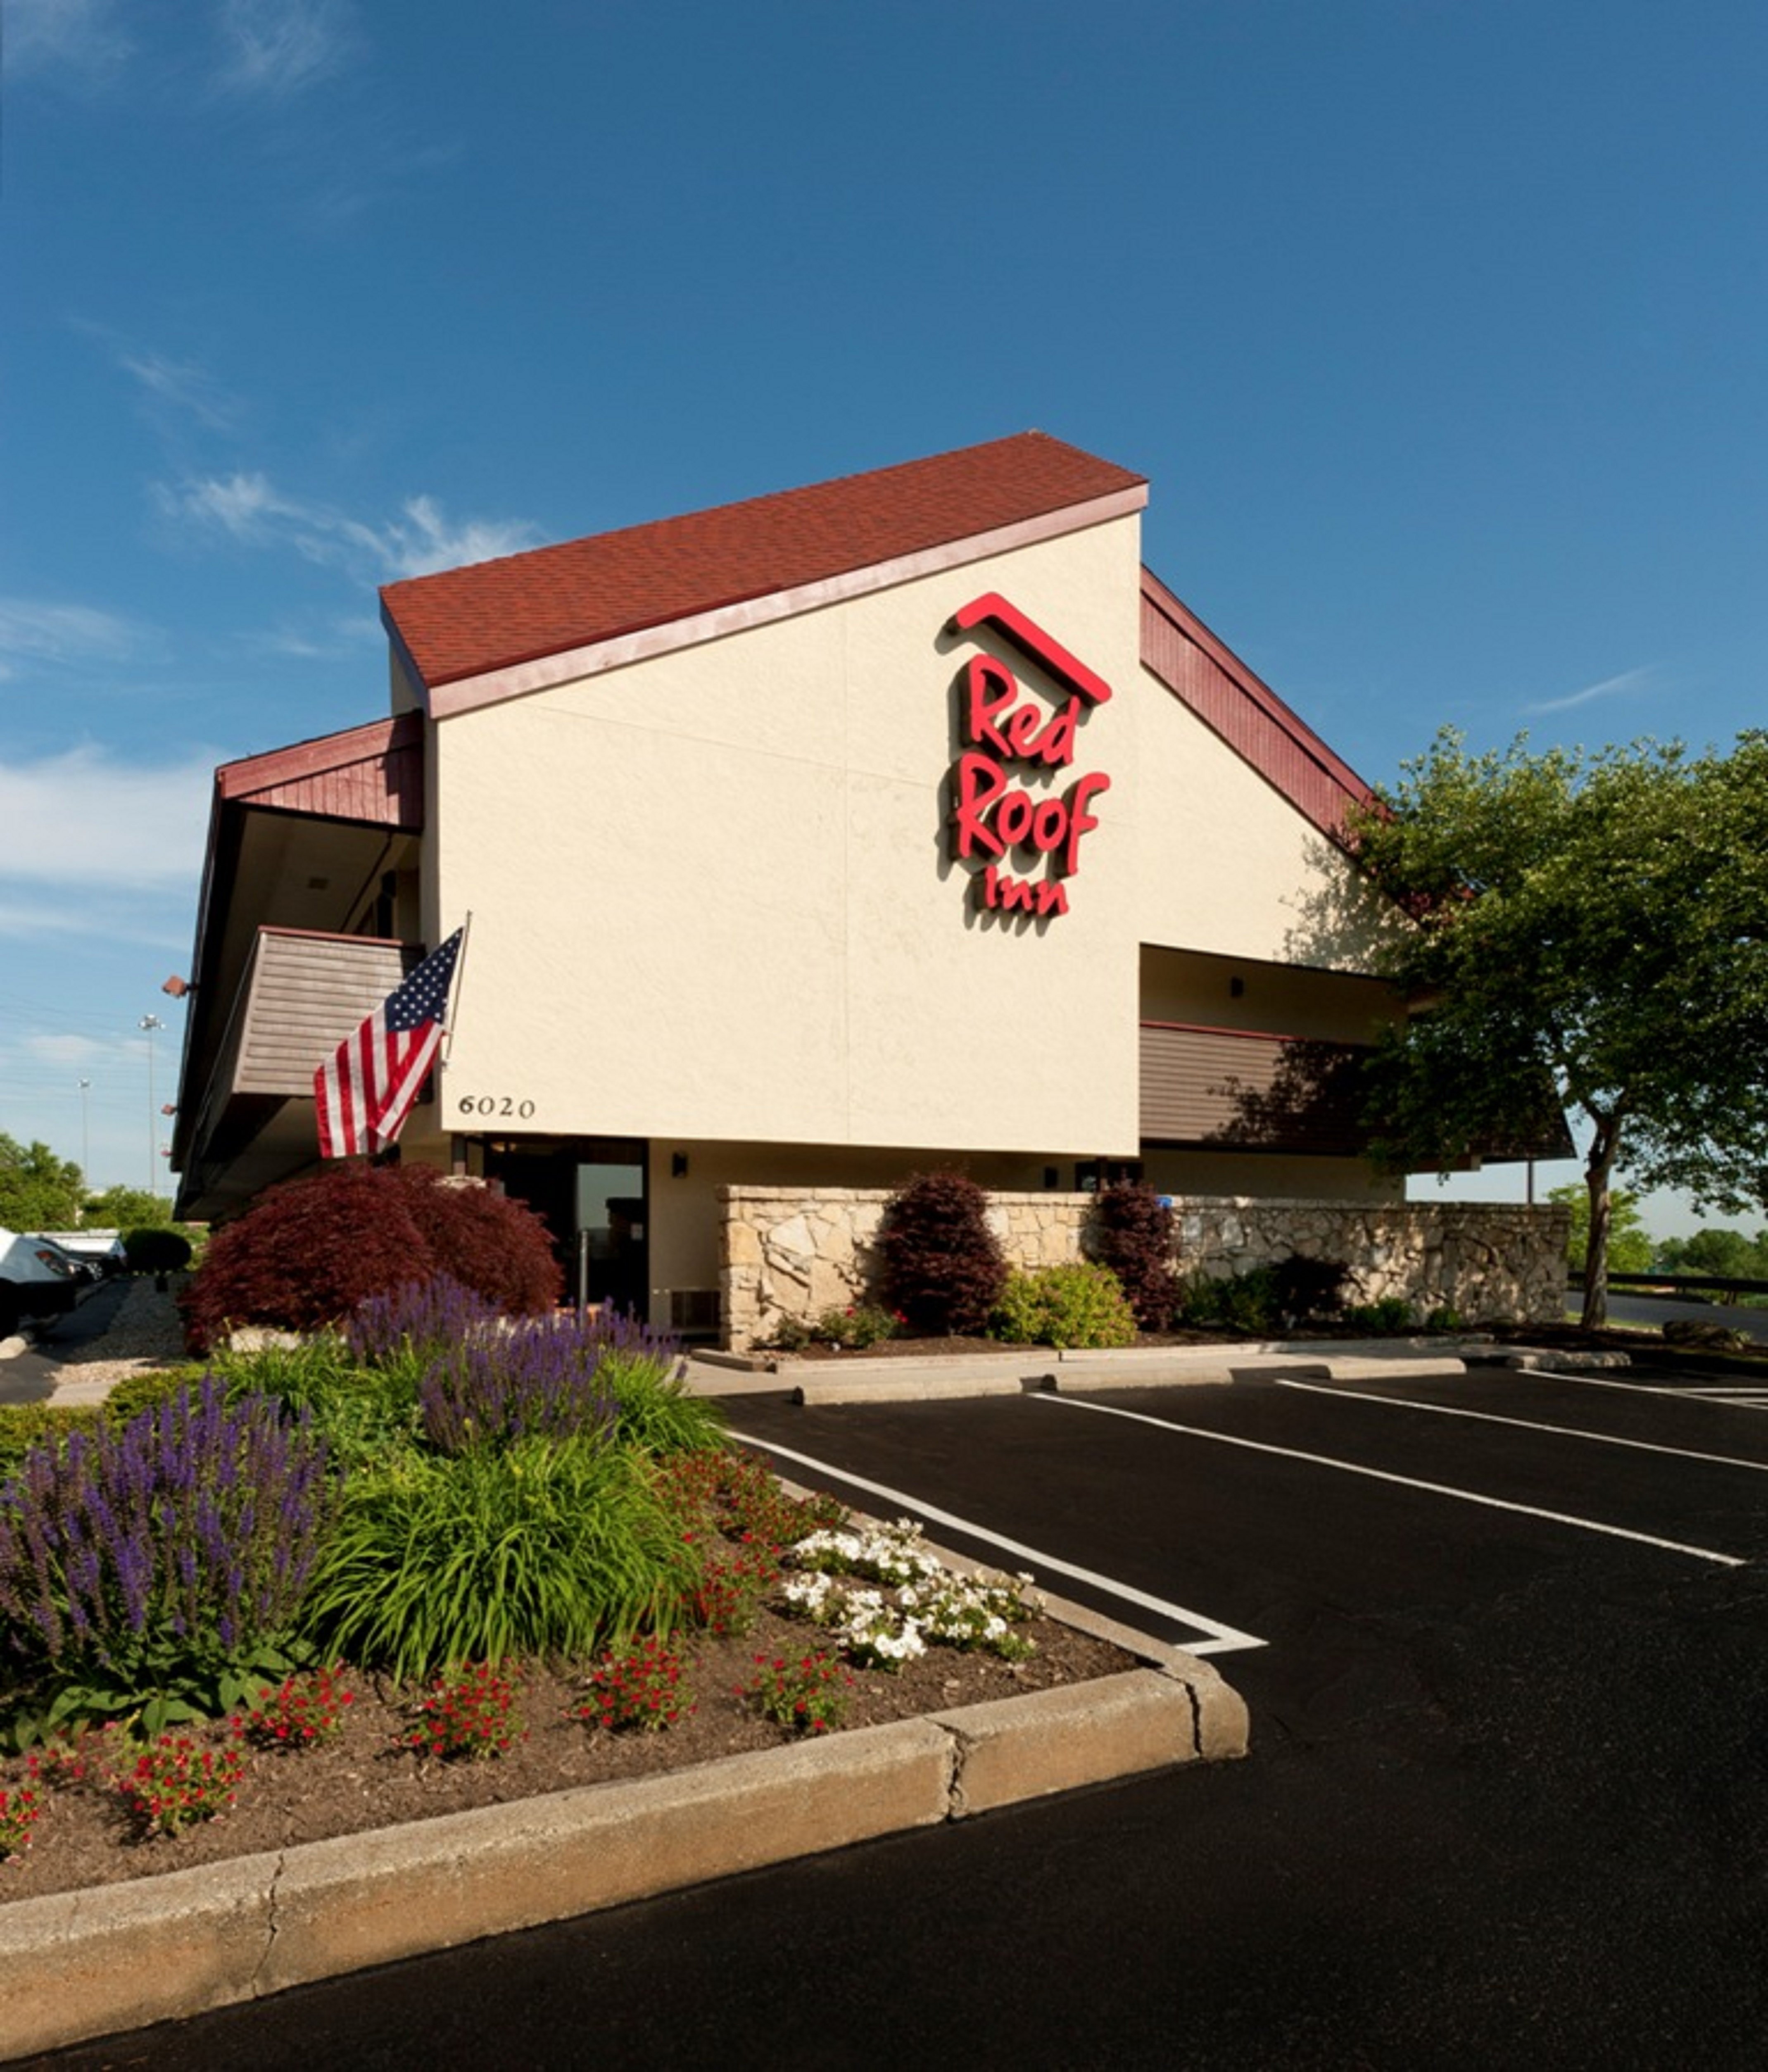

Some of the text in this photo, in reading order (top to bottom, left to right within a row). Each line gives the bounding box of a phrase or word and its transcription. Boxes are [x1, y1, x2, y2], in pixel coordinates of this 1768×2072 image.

[967, 652, 1081, 767] Red
[956, 751, 1111, 877] Roof
[984, 863, 1069, 916] Inn
[458, 1095, 535, 1119] 6020
